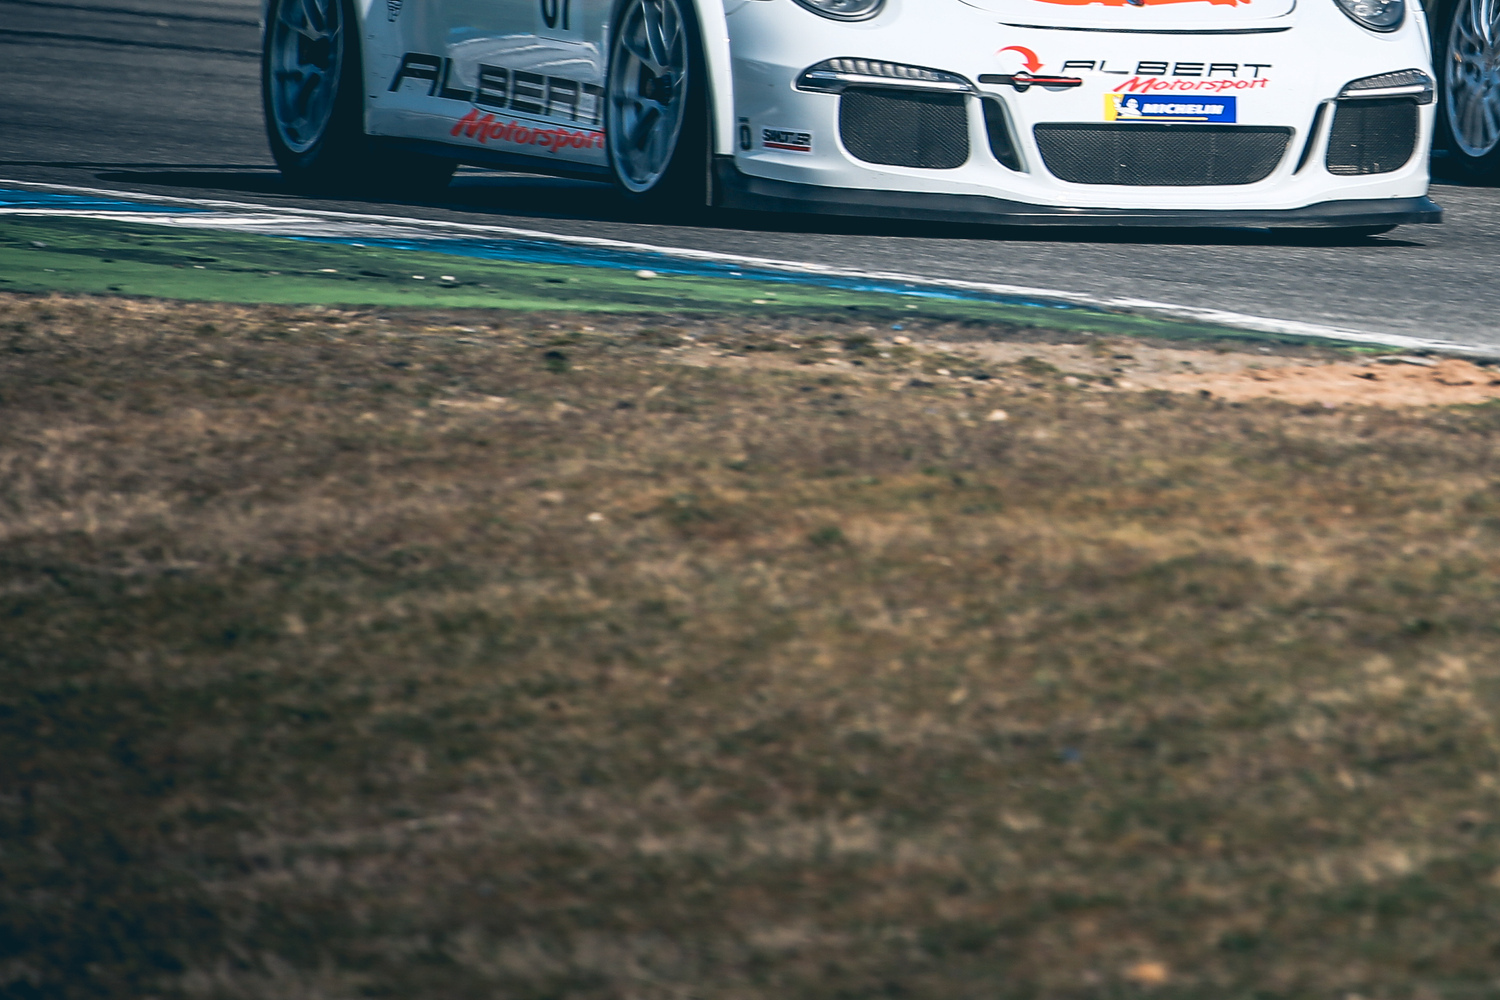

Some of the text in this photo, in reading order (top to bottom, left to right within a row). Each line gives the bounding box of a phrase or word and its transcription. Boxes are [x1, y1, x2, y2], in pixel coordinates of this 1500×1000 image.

[1060, 60, 1272, 78] ALBERT
[1112, 75, 1270, 94] Motorsport
[1141, 102, 1225, 116] MICHELIN
